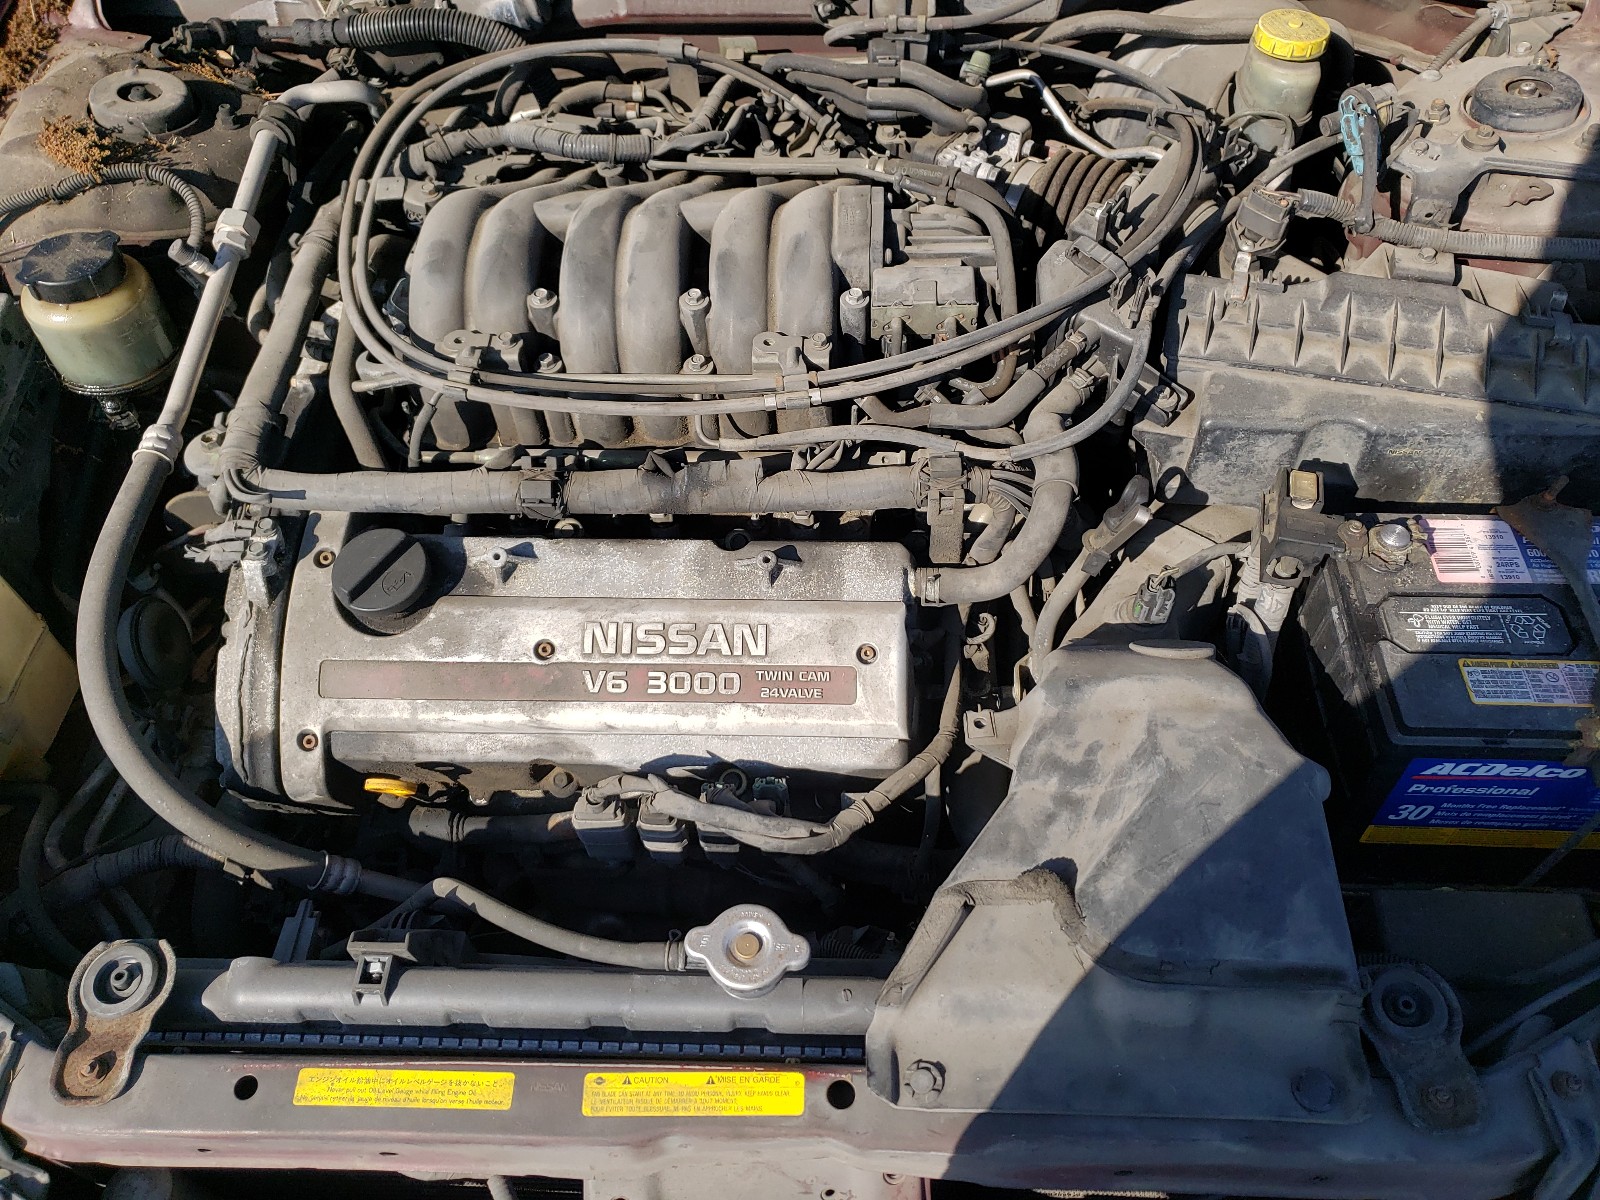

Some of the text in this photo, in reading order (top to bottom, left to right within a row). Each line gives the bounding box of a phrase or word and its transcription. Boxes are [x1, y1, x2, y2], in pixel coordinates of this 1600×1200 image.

[581, 621, 768, 657] NISSAN
[582, 669, 742, 696] V6 3000
[754, 669, 832, 683] TWIN CAM
[759, 686, 824, 699] 24VALVE
[1419, 762, 1587, 779] ACDelco
[1407, 783, 1541, 796] Professional
[1387, 804, 1435, 821] 30
[633, 1076, 669, 1084] CAUTION
[717, 1076, 781, 1084] MISE EN GARDE
[446, 1089, 467, 1098] Engine
